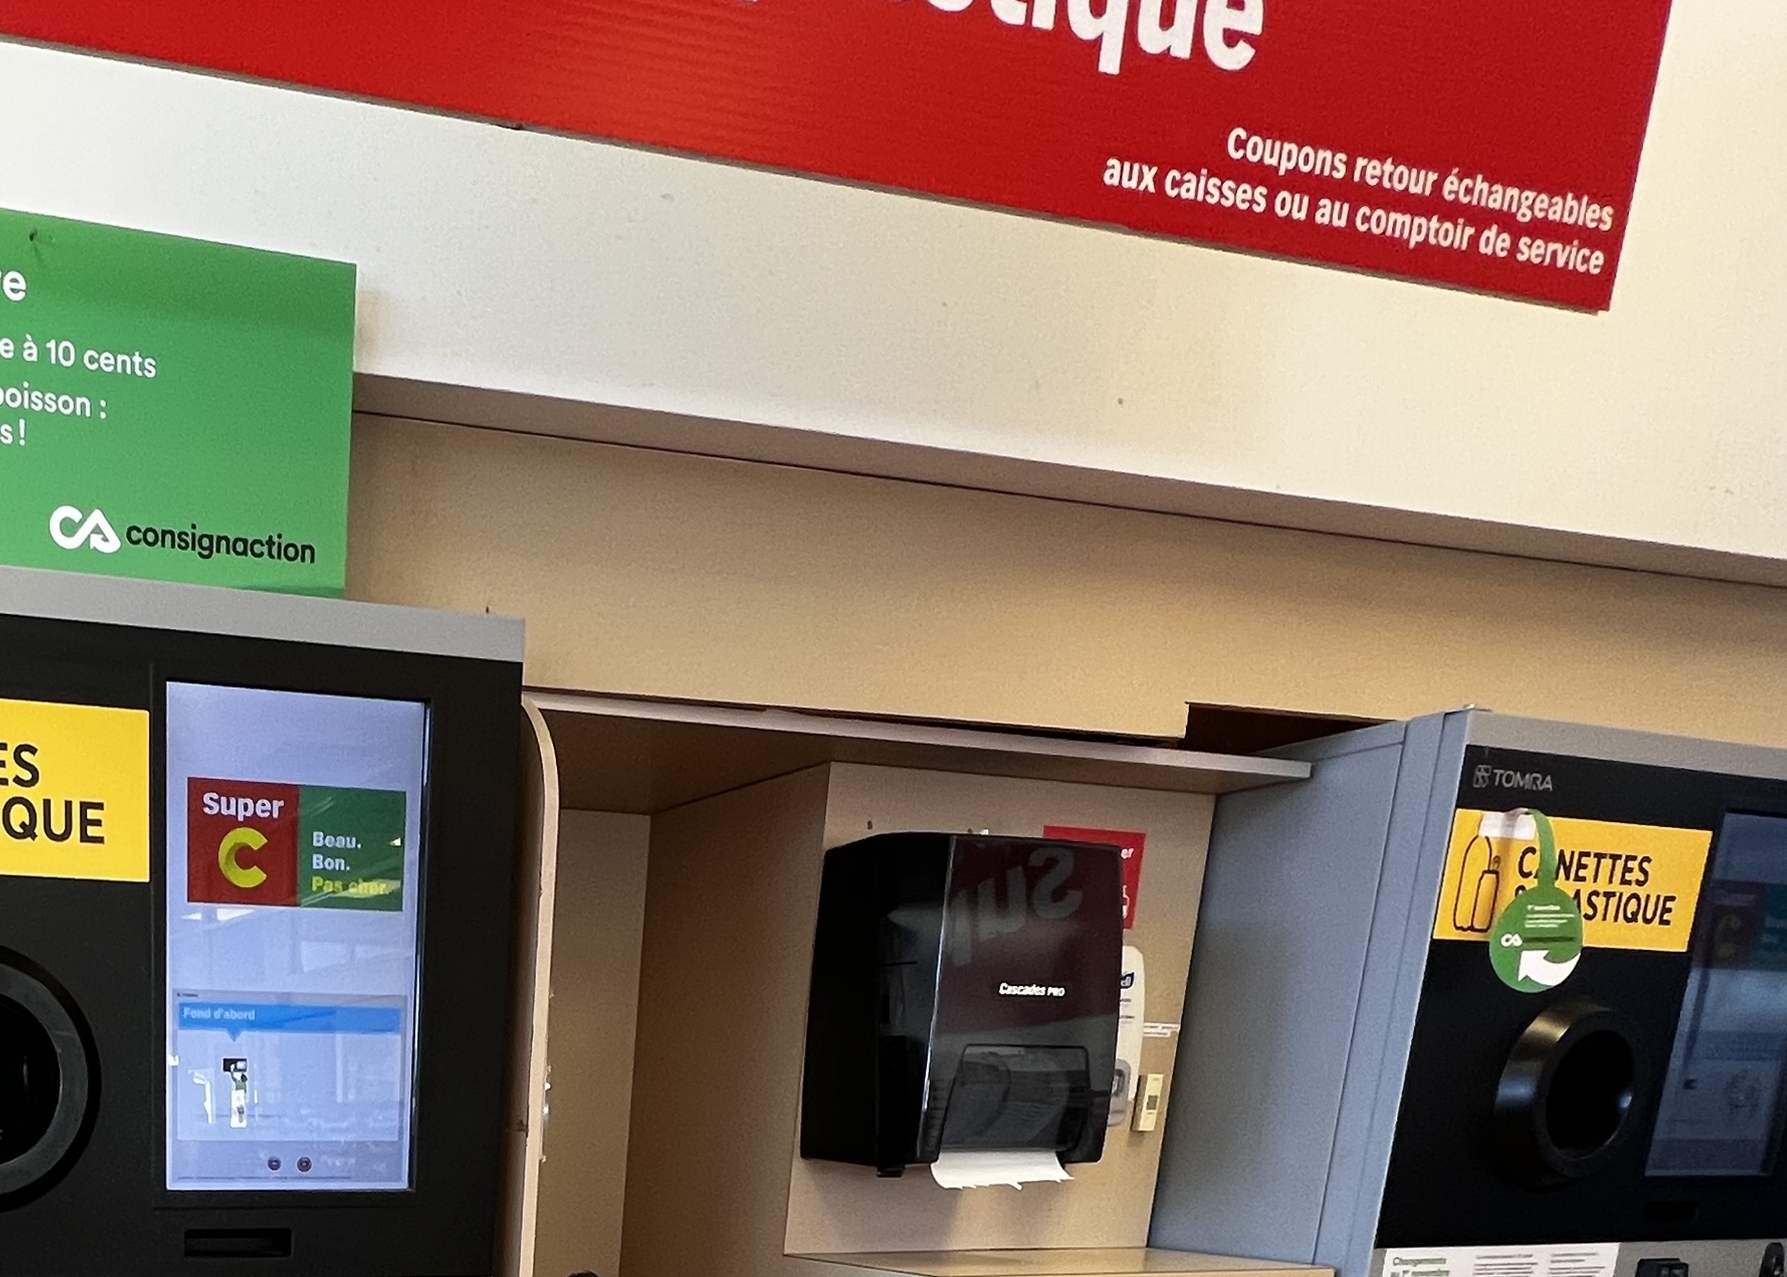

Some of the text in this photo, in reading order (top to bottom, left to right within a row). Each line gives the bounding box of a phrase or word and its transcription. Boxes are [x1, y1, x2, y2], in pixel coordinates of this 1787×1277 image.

[1227, 127, 1614, 233] Coupons retour échangeables
[1103, 157, 1605, 276] aux caisses ou au comptoir de service
[22, 333, 39, 363] à
[45, 339, 76, 368] 10
[83, 344, 157, 379] cents
[126, 521, 316, 566] consignaction
[1492, 769, 1553, 791] TOMRA
[202, 792, 285, 822] Super
[313, 831, 362, 849] Beau.
[218, 826, 268, 888] C
[313, 854, 351, 871] Bon.
[1518, 846, 1653, 887] CNETTES
[312, 876, 343, 892] Pas
[1571, 889, 1677, 926] STIQUE
[999, 982, 1046, 996] Cascades
[183, 1007, 211, 1019] Fond
